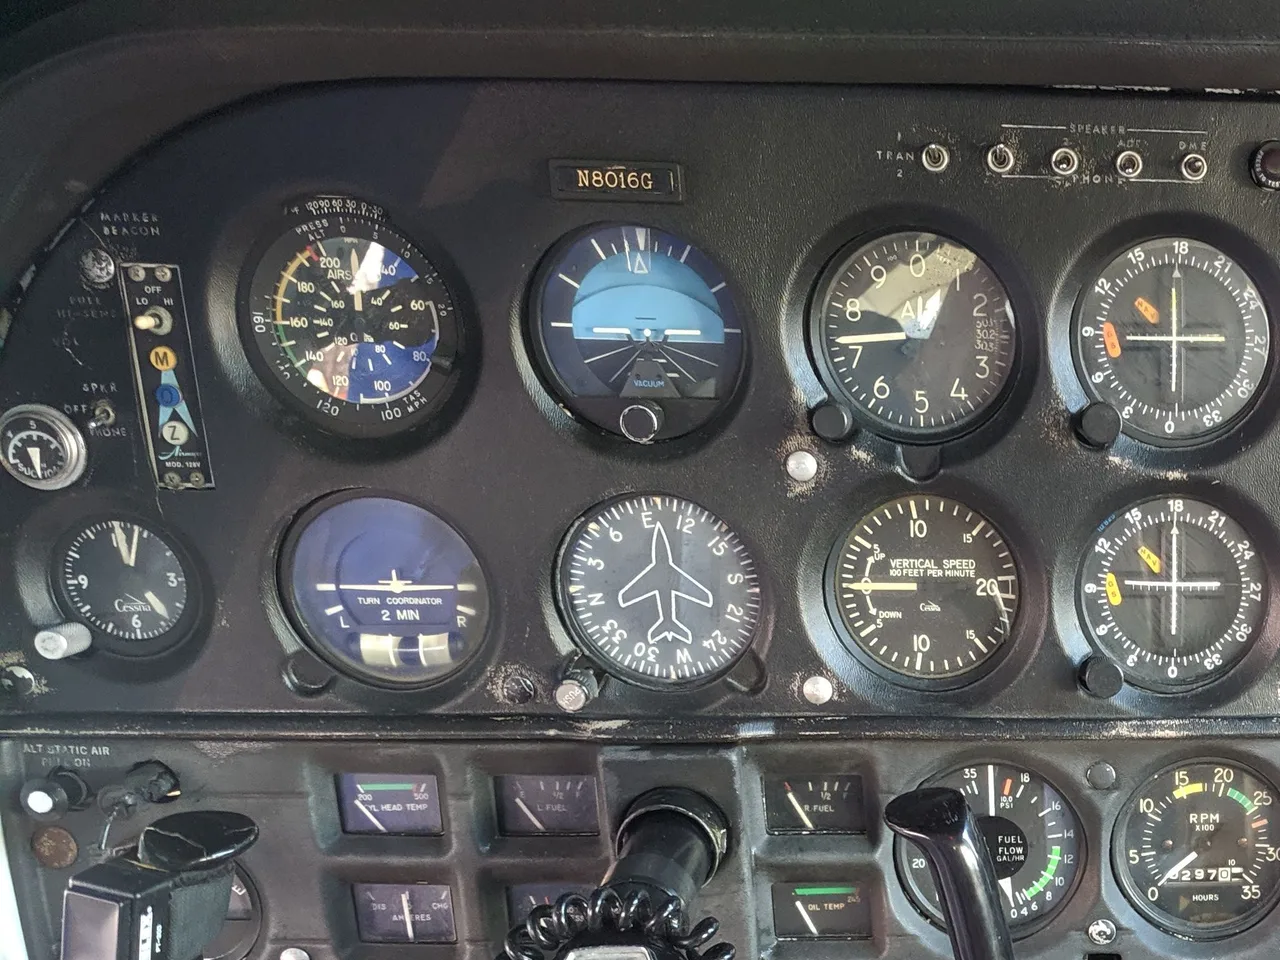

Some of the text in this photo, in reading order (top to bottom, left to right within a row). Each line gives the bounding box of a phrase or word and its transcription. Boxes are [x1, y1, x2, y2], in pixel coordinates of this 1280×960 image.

[1070, 123, 1125, 135] SPEAKER
[876, 150, 914, 161] TRAN
[577, 169, 654, 190] N8016G
[100, 212, 159, 223] MARKER
[103, 226, 160, 236] BEACON
[1173, 241, 1189, 255] 18
[320, 257, 341, 269] 200
[870, 265, 887, 289] 9
[144, 286, 161, 294] OFF
[297, 282, 315, 294] 180
[845, 298, 862, 321] 8
[972, 293, 988, 317] 2
[290, 317, 308, 328] 160
[305, 351, 324, 362] 140
[848, 345, 863, 369] 7
[975, 355, 990, 378] 3
[374, 380, 392, 392] 100
[633, 379, 665, 388] VACUUM
[873, 375, 890, 399] 6
[950, 378, 969, 400] 4
[914, 390, 930, 413] 5
[641, 512, 655, 529] E
[909, 519, 927, 538] 10
[890, 559, 976, 569] VERTICAL SPEED
[889, 568, 975, 578] 100 FEET PER MINUTE
[114, 592, 151, 613] Cessna
[357, 597, 443, 605] TURN COORDINATOR
[381, 609, 420, 621] 2 MIN
[879, 611, 902, 619] DOWN
[913, 634, 930, 652] 10
[23, 743, 110, 755] ALT STATIC AIR
[1175, 771, 1190, 786] 15
[1213, 768, 1234, 783] 20
[1253, 791, 1272, 806] 25
[1139, 799, 1154, 814] 10
[1189, 813, 1219, 823] RPM
[998, 835, 1023, 844] FUEL
[999, 846, 1024, 855] FLOW
[996, 854, 1025, 862] GAL/HR
[1192, 894, 1219, 902] HOURS
[1240, 885, 1262, 900] 35
[432, 902, 449, 910] CHG
[808, 903, 845, 911] OIL TEMP
